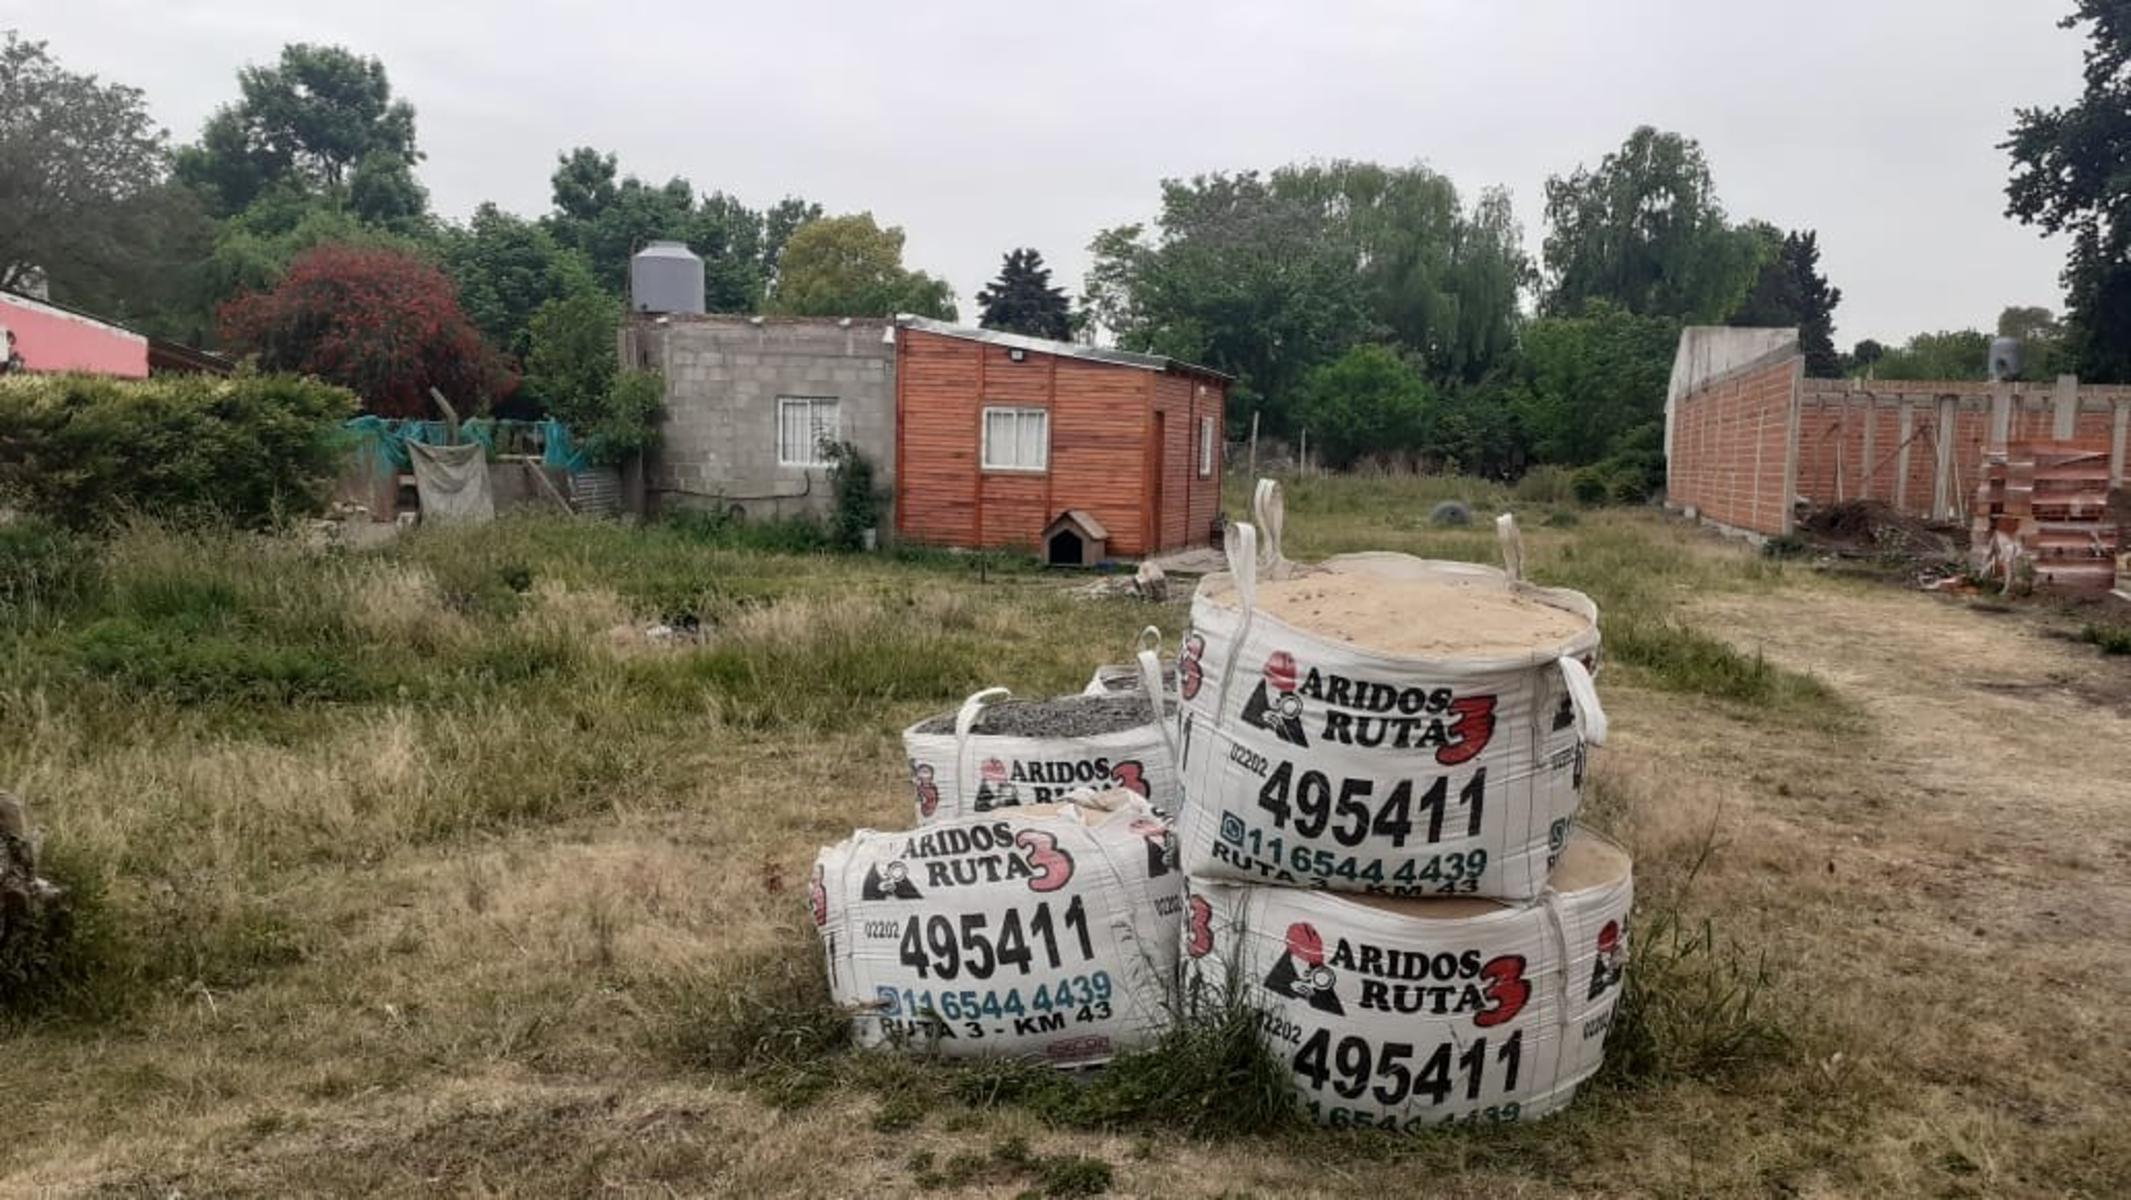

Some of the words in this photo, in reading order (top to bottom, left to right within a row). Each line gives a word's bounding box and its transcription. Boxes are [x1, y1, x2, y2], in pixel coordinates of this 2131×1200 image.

[1300, 667, 1453, 715] ARIDOS
[1322, 710, 1449, 749] RUTA
[1435, 694, 1497, 766] 3
[1011, 757, 1112, 783] ARIDOS
[1229, 743, 1268, 777] 02202
[1257, 760, 1487, 847] 495411
[901, 822, 1015, 859] ARIDOS
[926, 854, 1032, 887] RUTA
[1016, 828, 1074, 893] 3
[1212, 840, 1296, 883] RUTA
[1365, 884, 1423, 897] KM
[1436, 879, 1480, 894] 43
[1393, 849, 1487, 884] 4439
[865, 920, 899, 939] 02202
[900, 894, 1094, 980] 495411
[1330, 937, 1481, 981] ARIDOS
[1032, 970, 1112, 1013] 4439
[1358, 979, 1486, 1015] RUTA
[1473, 954, 1531, 1028] 3
[880, 1018, 957, 1040] RUTA
[965, 1022, 985, 1038] 3
[1013, 1012, 1065, 1035] KM
[1076, 1001, 1112, 1023] 43
[1256, 1011, 1301, 1044] 2202
[1292, 1027, 1523, 1105] 495411
